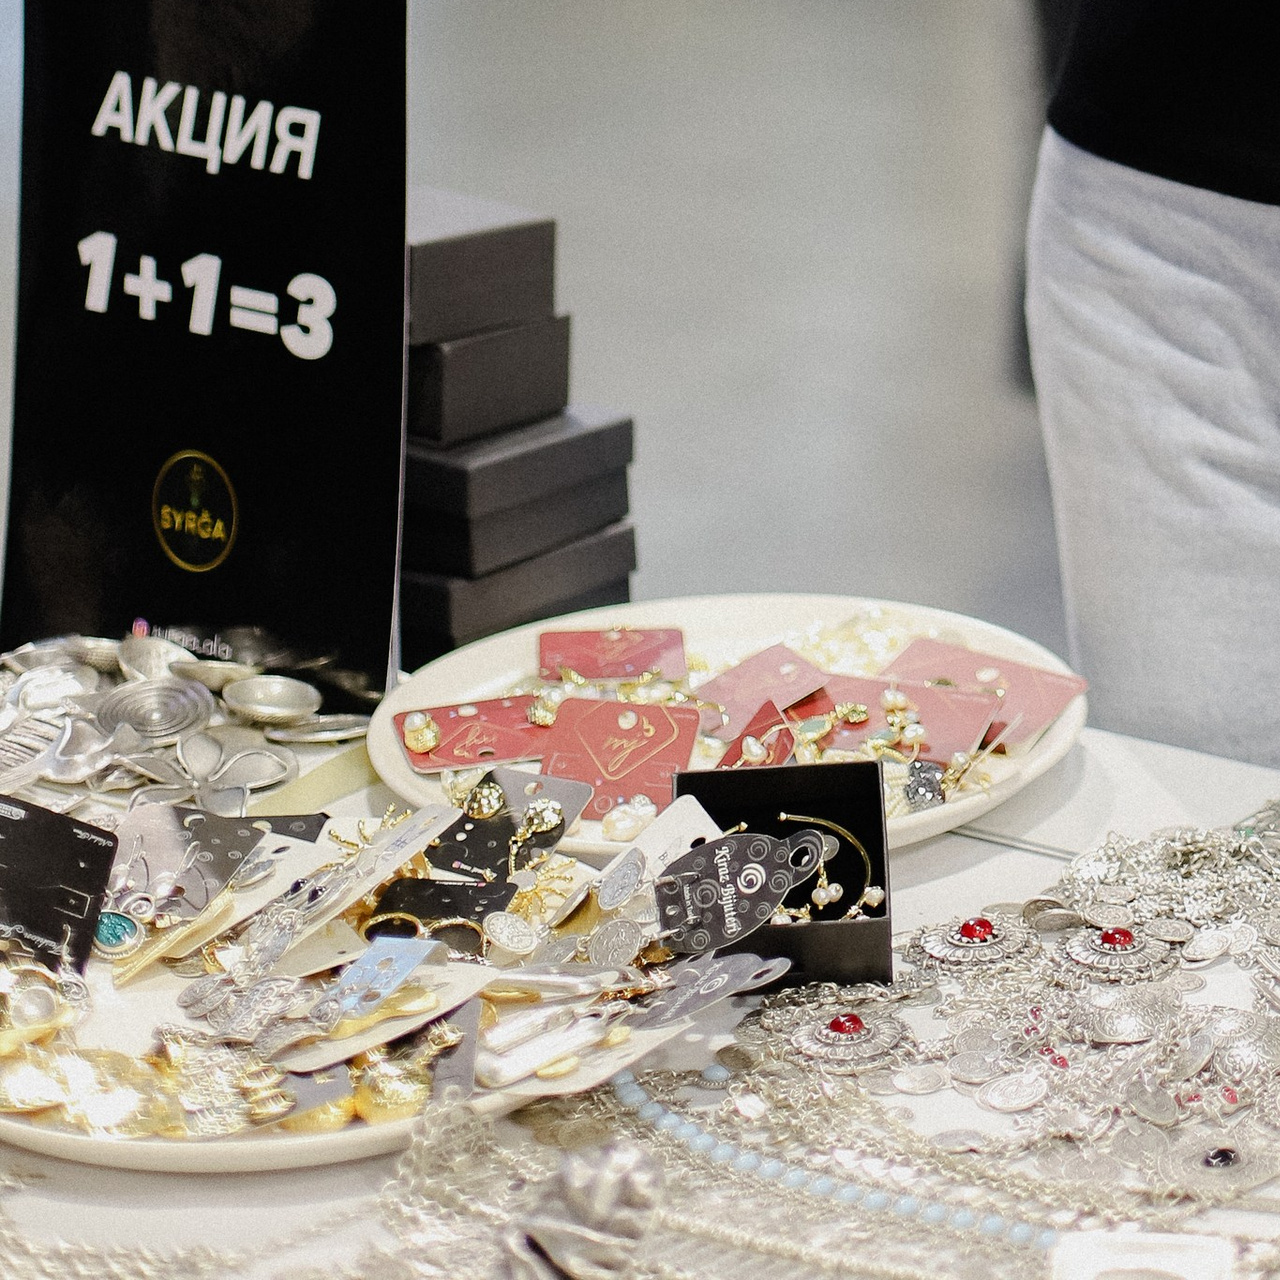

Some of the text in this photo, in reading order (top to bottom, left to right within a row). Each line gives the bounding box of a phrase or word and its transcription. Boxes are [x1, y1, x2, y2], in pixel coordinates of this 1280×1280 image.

[92, 71, 321, 180] АКЦИЯ
[77, 231, 337, 360] 1+1=3
[714, 846, 742, 935] Kiraz Bijuteri
